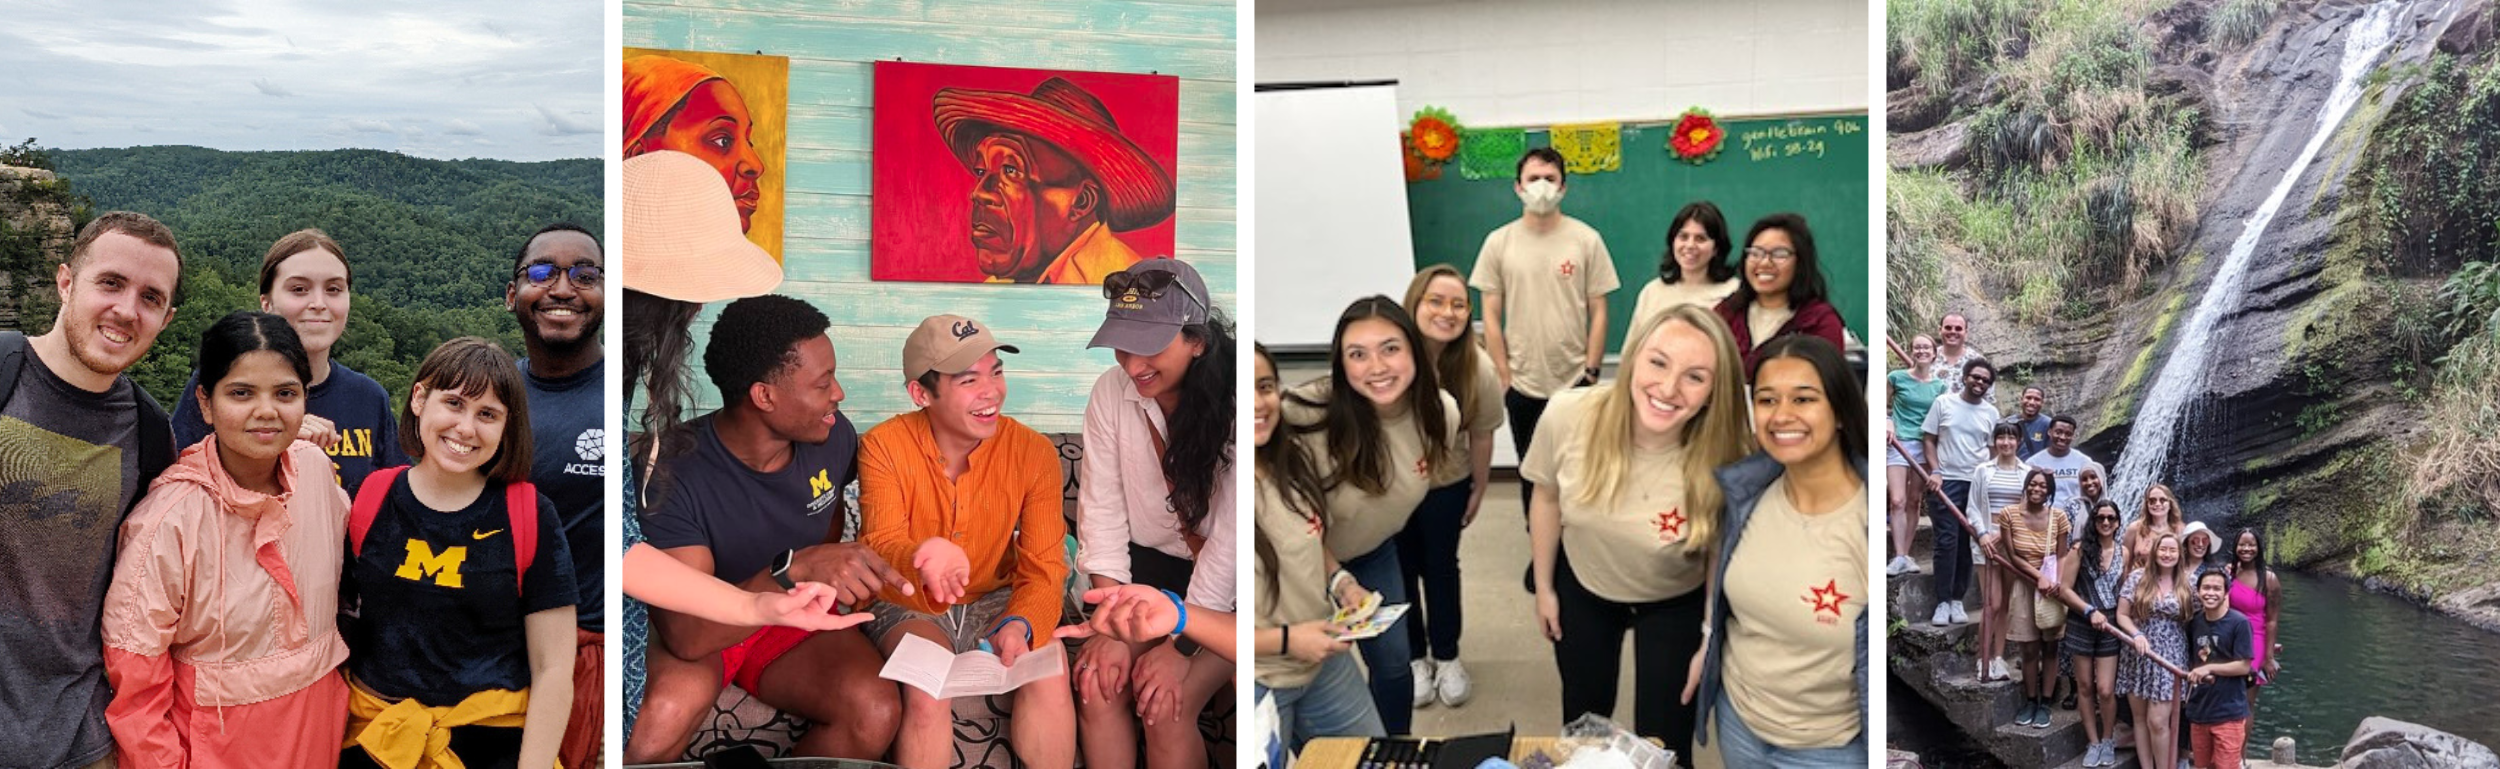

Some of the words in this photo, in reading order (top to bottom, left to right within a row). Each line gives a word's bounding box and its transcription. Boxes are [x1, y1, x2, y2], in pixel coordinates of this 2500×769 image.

[951, 320, 979, 342] Cal
[562, 462, 605, 477] ACCES
[809, 468, 833, 499] M
[394, 538, 467, 588] M
